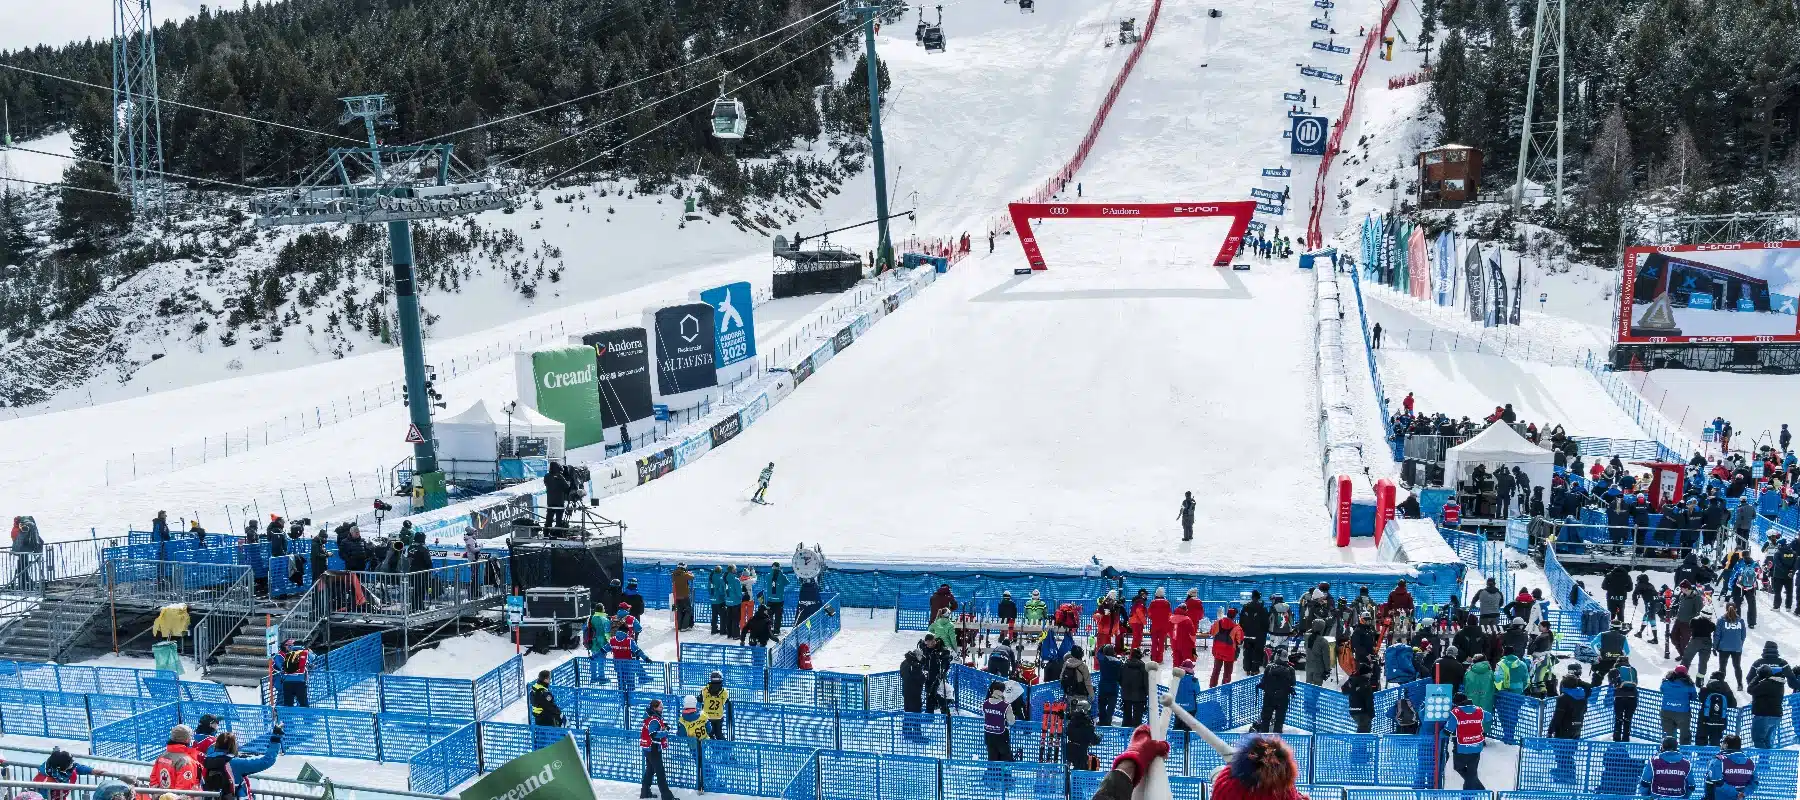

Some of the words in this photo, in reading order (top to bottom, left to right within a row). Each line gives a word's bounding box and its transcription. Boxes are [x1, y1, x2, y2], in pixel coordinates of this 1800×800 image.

[1109, 207, 1140, 215] Andorra
[1696, 243, 1741, 251] e-tron
[1627, 253, 1635, 268] Cup
[1625, 269, 1633, 293] World
[1623, 293, 1631, 305] Ski
[1621, 318, 1629, 337] Audi
[720, 328, 746, 342] ANDORRA
[608, 339, 643, 353] Andorra
[722, 342, 747, 362] 2029
[663, 352, 713, 371] ALTAVISTA
[543, 363, 593, 389] Creand
[1724, 621, 1742, 630] USA
[708, 699, 721, 711] 23
[694, 725, 706, 738] 66
[489, 763, 556, 800] reand
